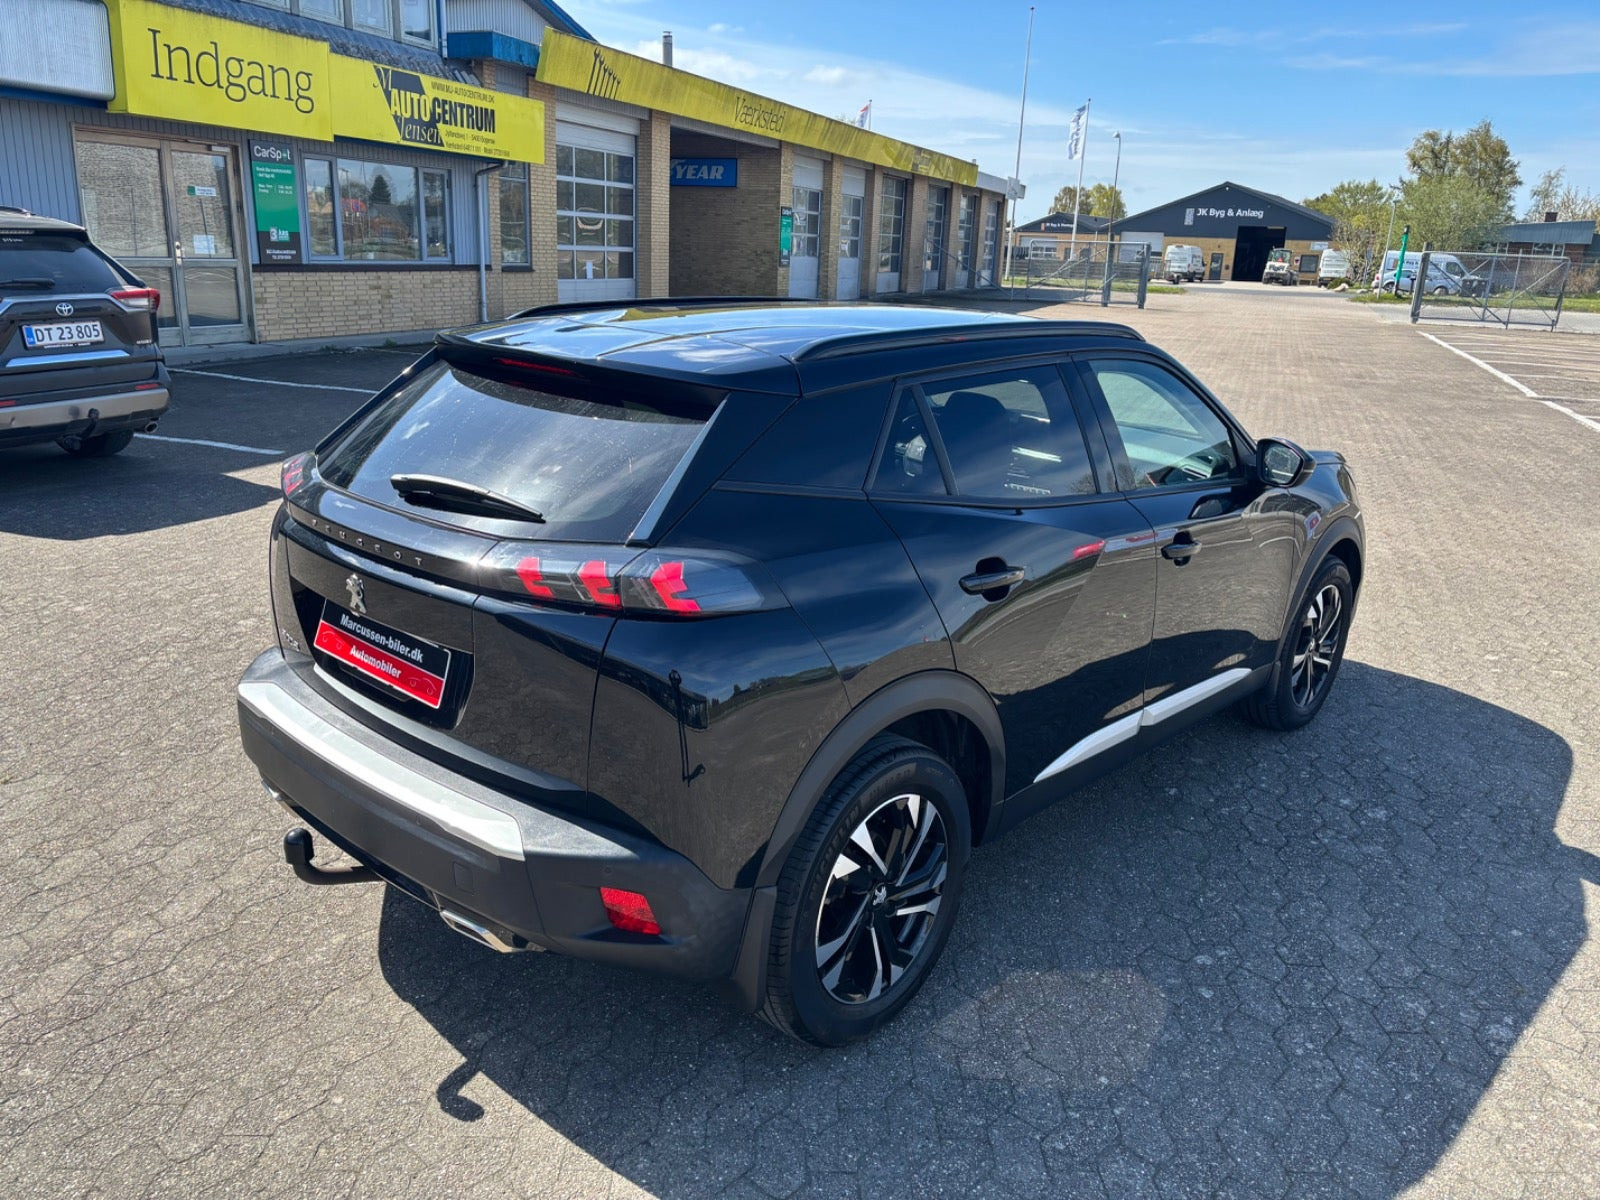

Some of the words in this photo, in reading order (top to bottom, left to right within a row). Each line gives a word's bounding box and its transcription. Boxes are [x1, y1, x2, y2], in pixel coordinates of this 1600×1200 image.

[148, 28, 315, 114] Indgang
[390, 88, 431, 123] AUTO
[432, 97, 496, 134] CENTRUM
[734, 96, 786, 133] Værksted
[398, 116, 442, 144] Jensen
[1196, 207, 1208, 216] JK
[1209, 208, 1226, 218] Byg
[1227, 208, 1235, 217] &
[1236, 208, 1264, 219] Anlæg
[35, 327, 53, 342] DT
[56, 326, 74, 340] 23
[76, 324, 100, 339] 805
[311, 519, 423, 566] PEUGEOT
[340, 613, 424, 663] Marcussen-biler.dk
[349, 645, 402, 679] Automobiler
